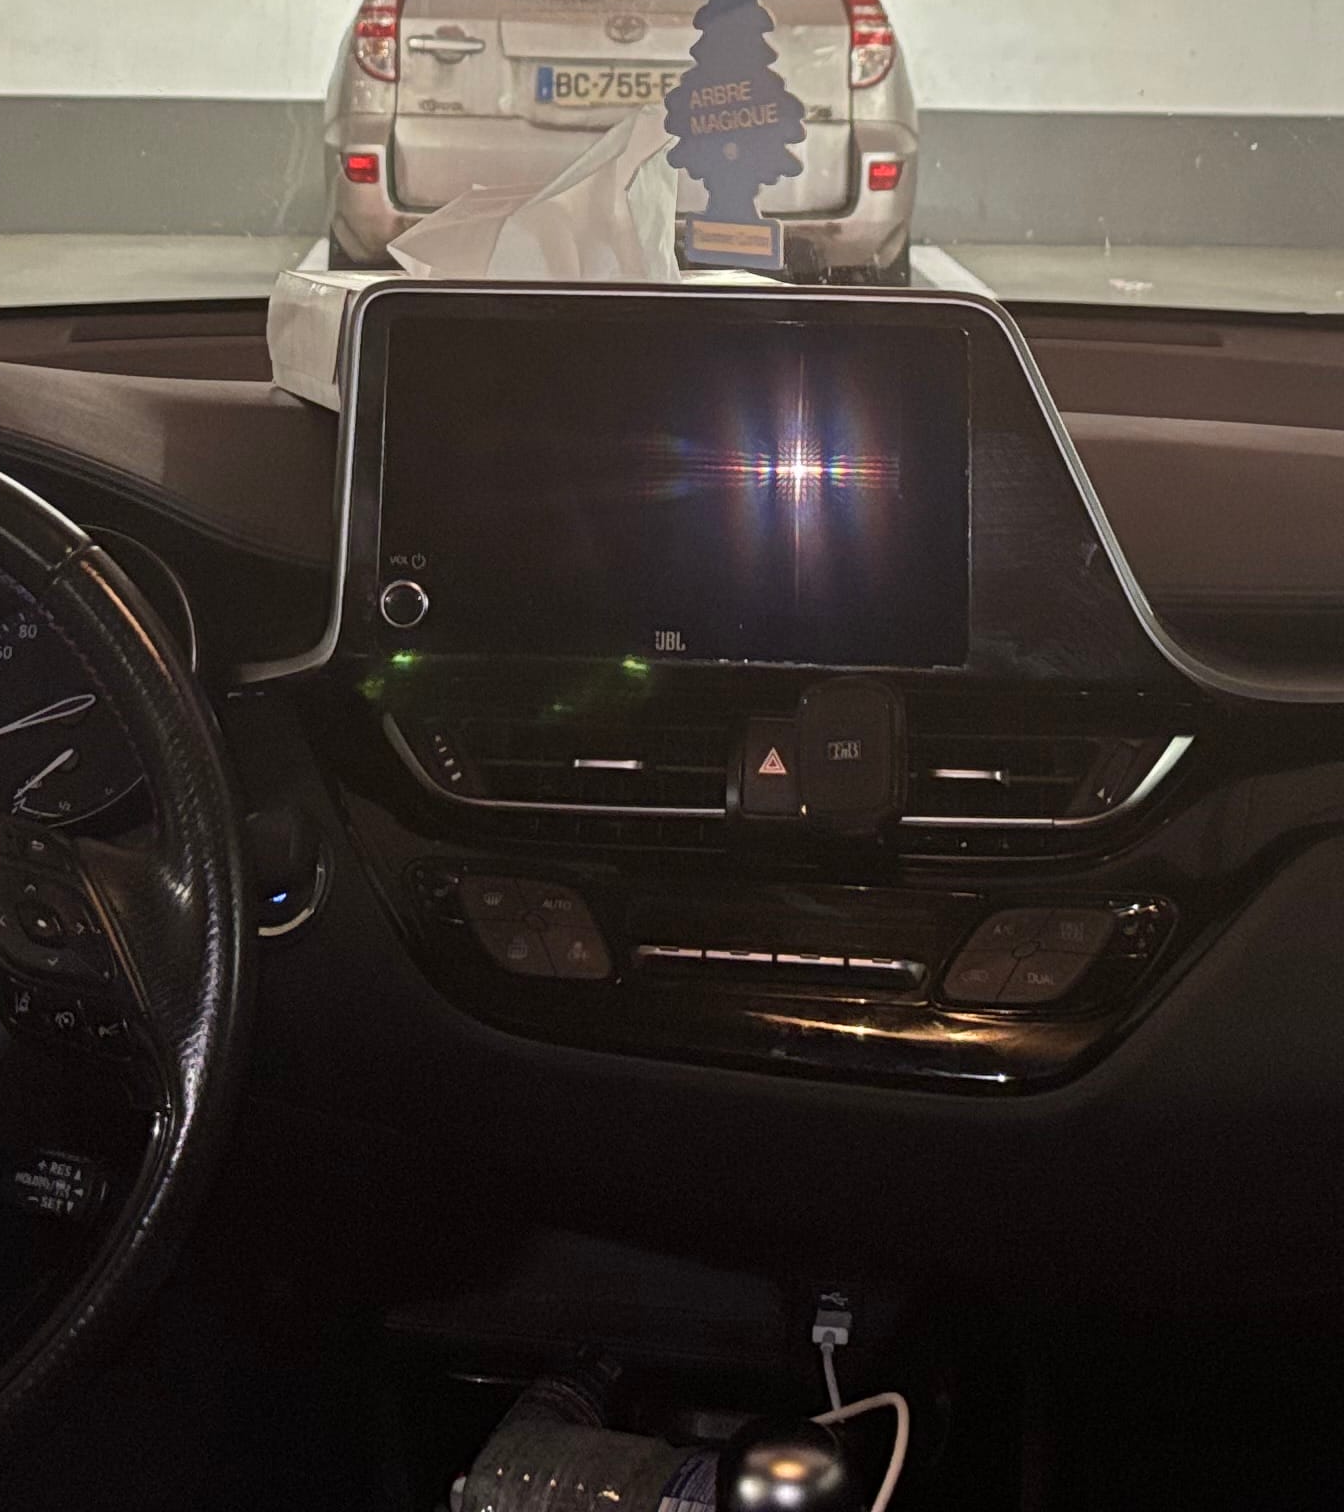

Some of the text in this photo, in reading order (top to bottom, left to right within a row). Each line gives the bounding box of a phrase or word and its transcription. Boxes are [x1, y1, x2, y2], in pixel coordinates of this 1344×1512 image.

[690, 82, 752, 109] ARBRE
[690, 103, 779, 136] MAGIQUE
[19, 624, 38, 639] 80
